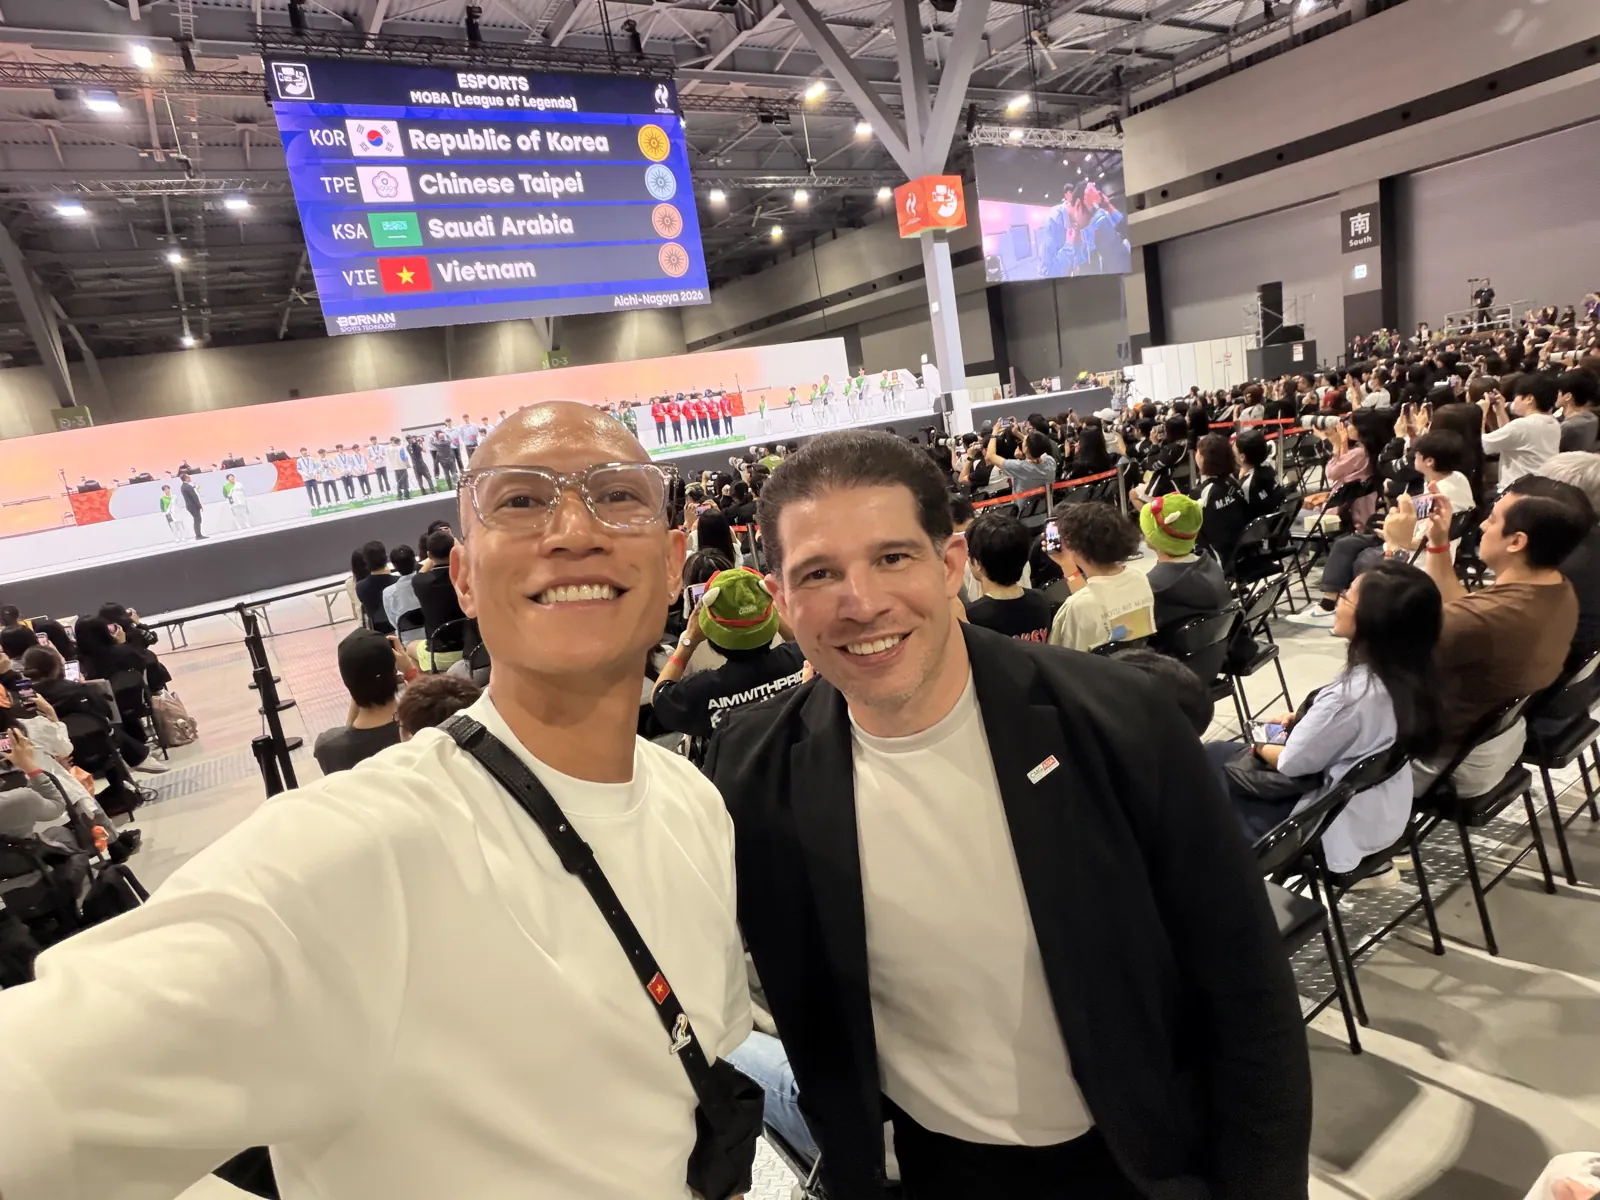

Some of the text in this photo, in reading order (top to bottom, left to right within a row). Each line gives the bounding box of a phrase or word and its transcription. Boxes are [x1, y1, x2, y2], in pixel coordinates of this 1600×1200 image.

[457, 73, 529, 91] ESPORTS
[410, 91, 578, 112] MOBA [League of Legends]
[309, 128, 610, 156] KOR Republic of Korea
[320, 171, 584, 198] TPE Chinese Taipei
[331, 223, 368, 240] KSA
[428, 214, 496, 239] Saudi
[501, 212, 575, 236] Arabia
[1349, 212, 1371, 236] 南
[1349, 236, 1372, 247] South
[342, 260, 537, 286] VIE Vietnam
[614, 289, 704, 307] Aichi-Nagoya 2026
[336, 312, 396, 327] BORNAN
